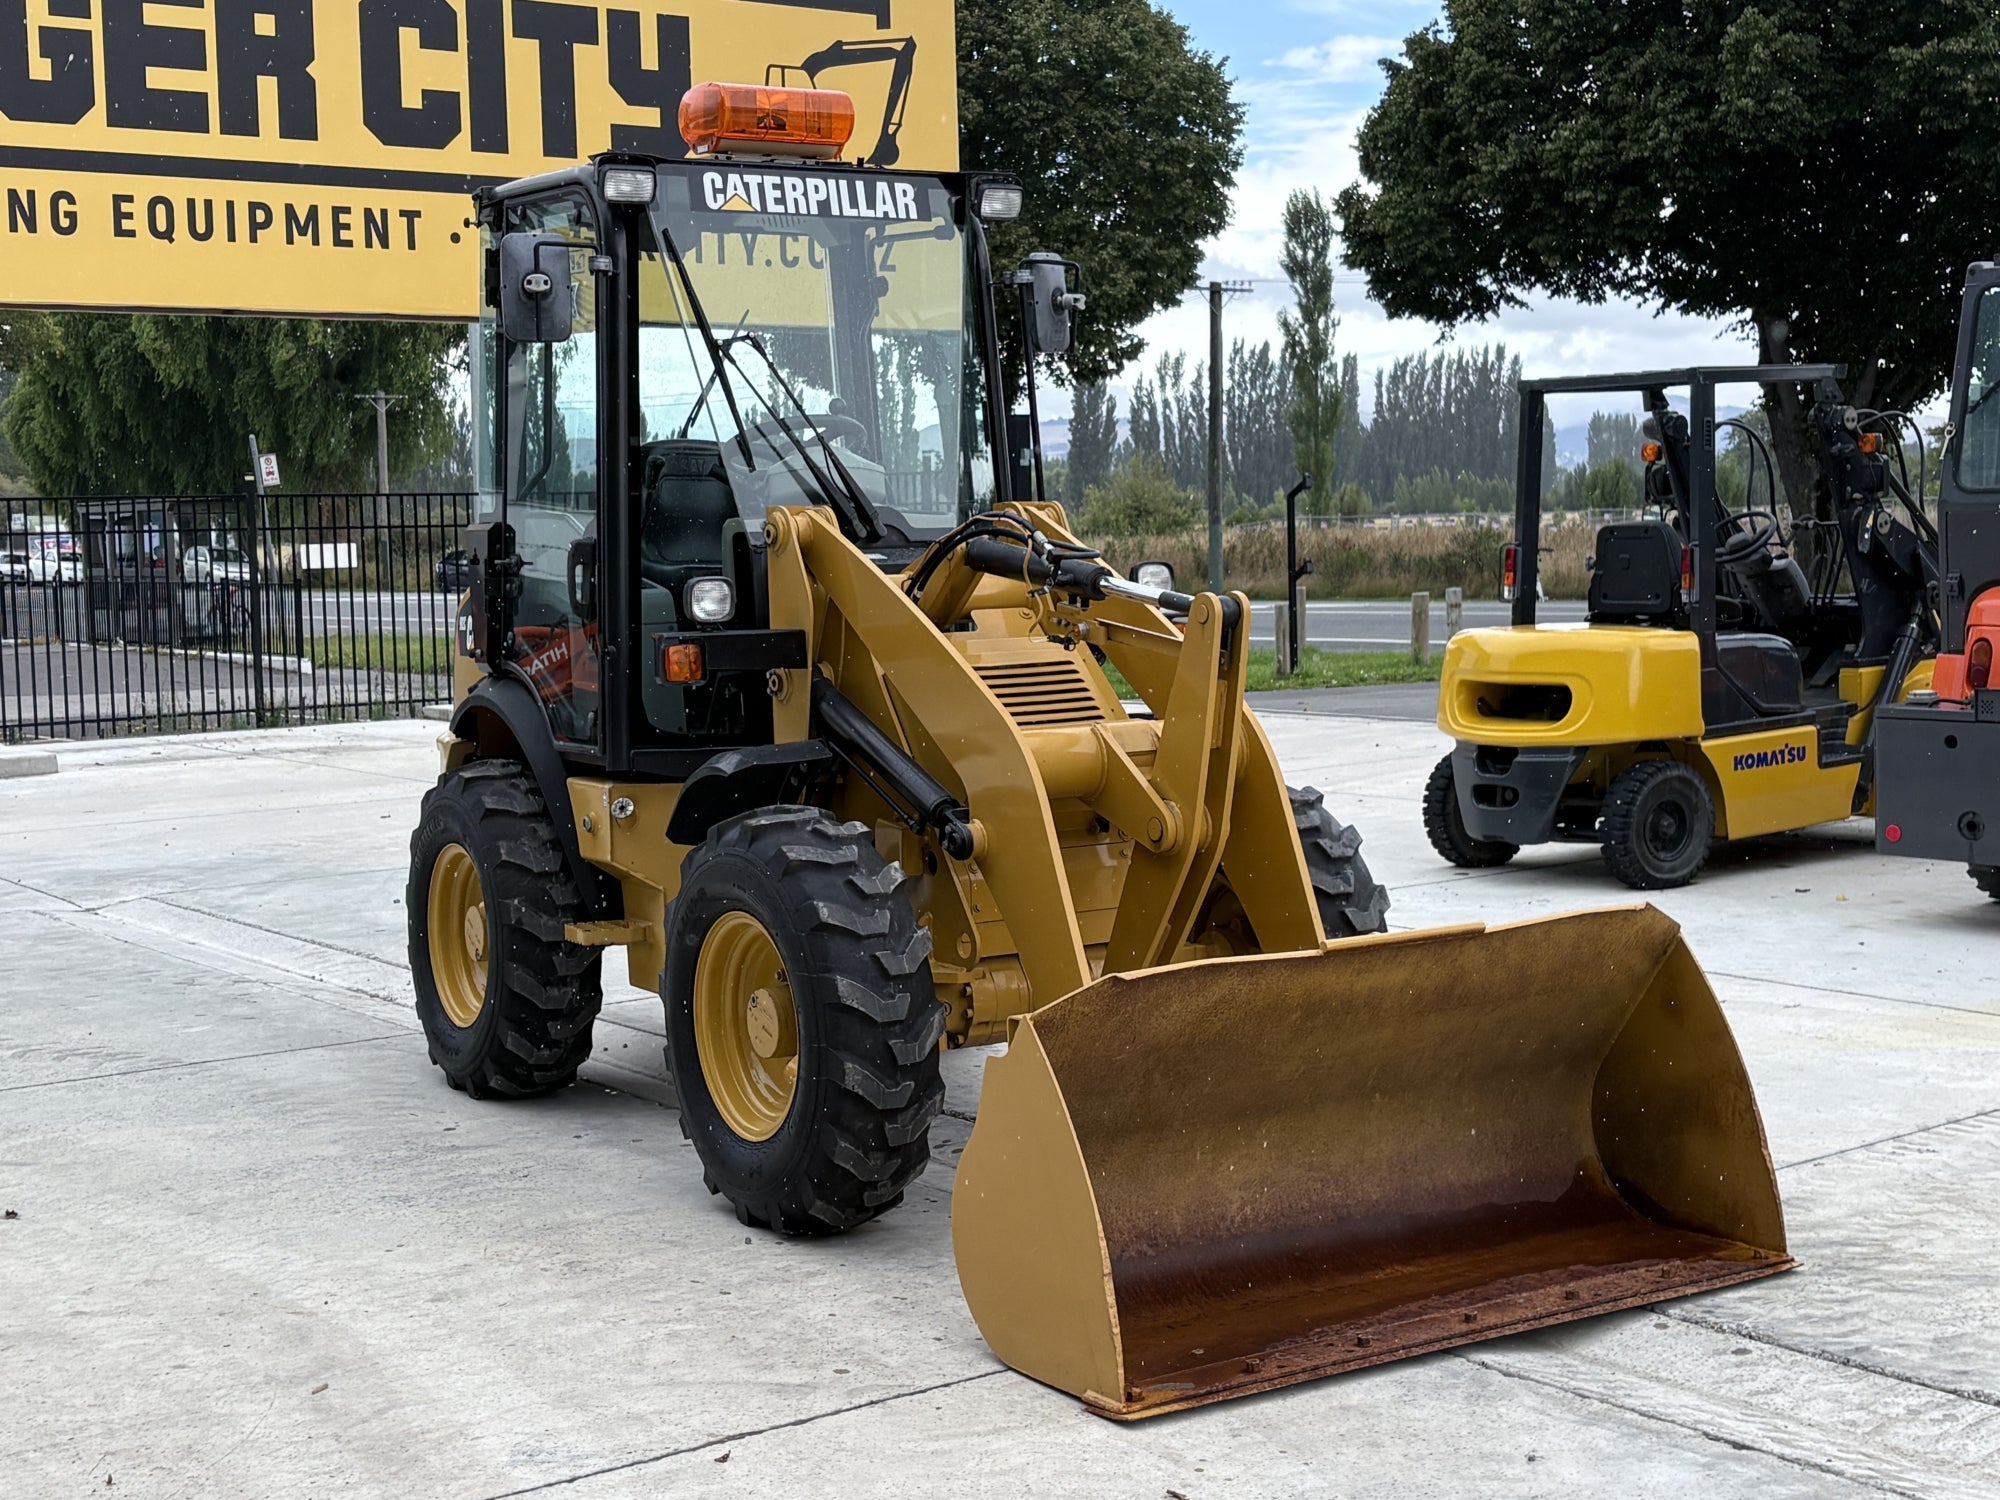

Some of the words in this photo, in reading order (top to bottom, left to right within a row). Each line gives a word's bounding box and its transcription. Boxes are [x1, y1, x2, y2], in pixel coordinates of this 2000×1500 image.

[358, 0, 693, 160] CITY
[7, 188, 79, 236] NG
[112, 193, 422, 251] EQUIPMENT
[702, 171, 918, 220] CATERPILLAR
[1733, 743, 1807, 772] KOMATSU
